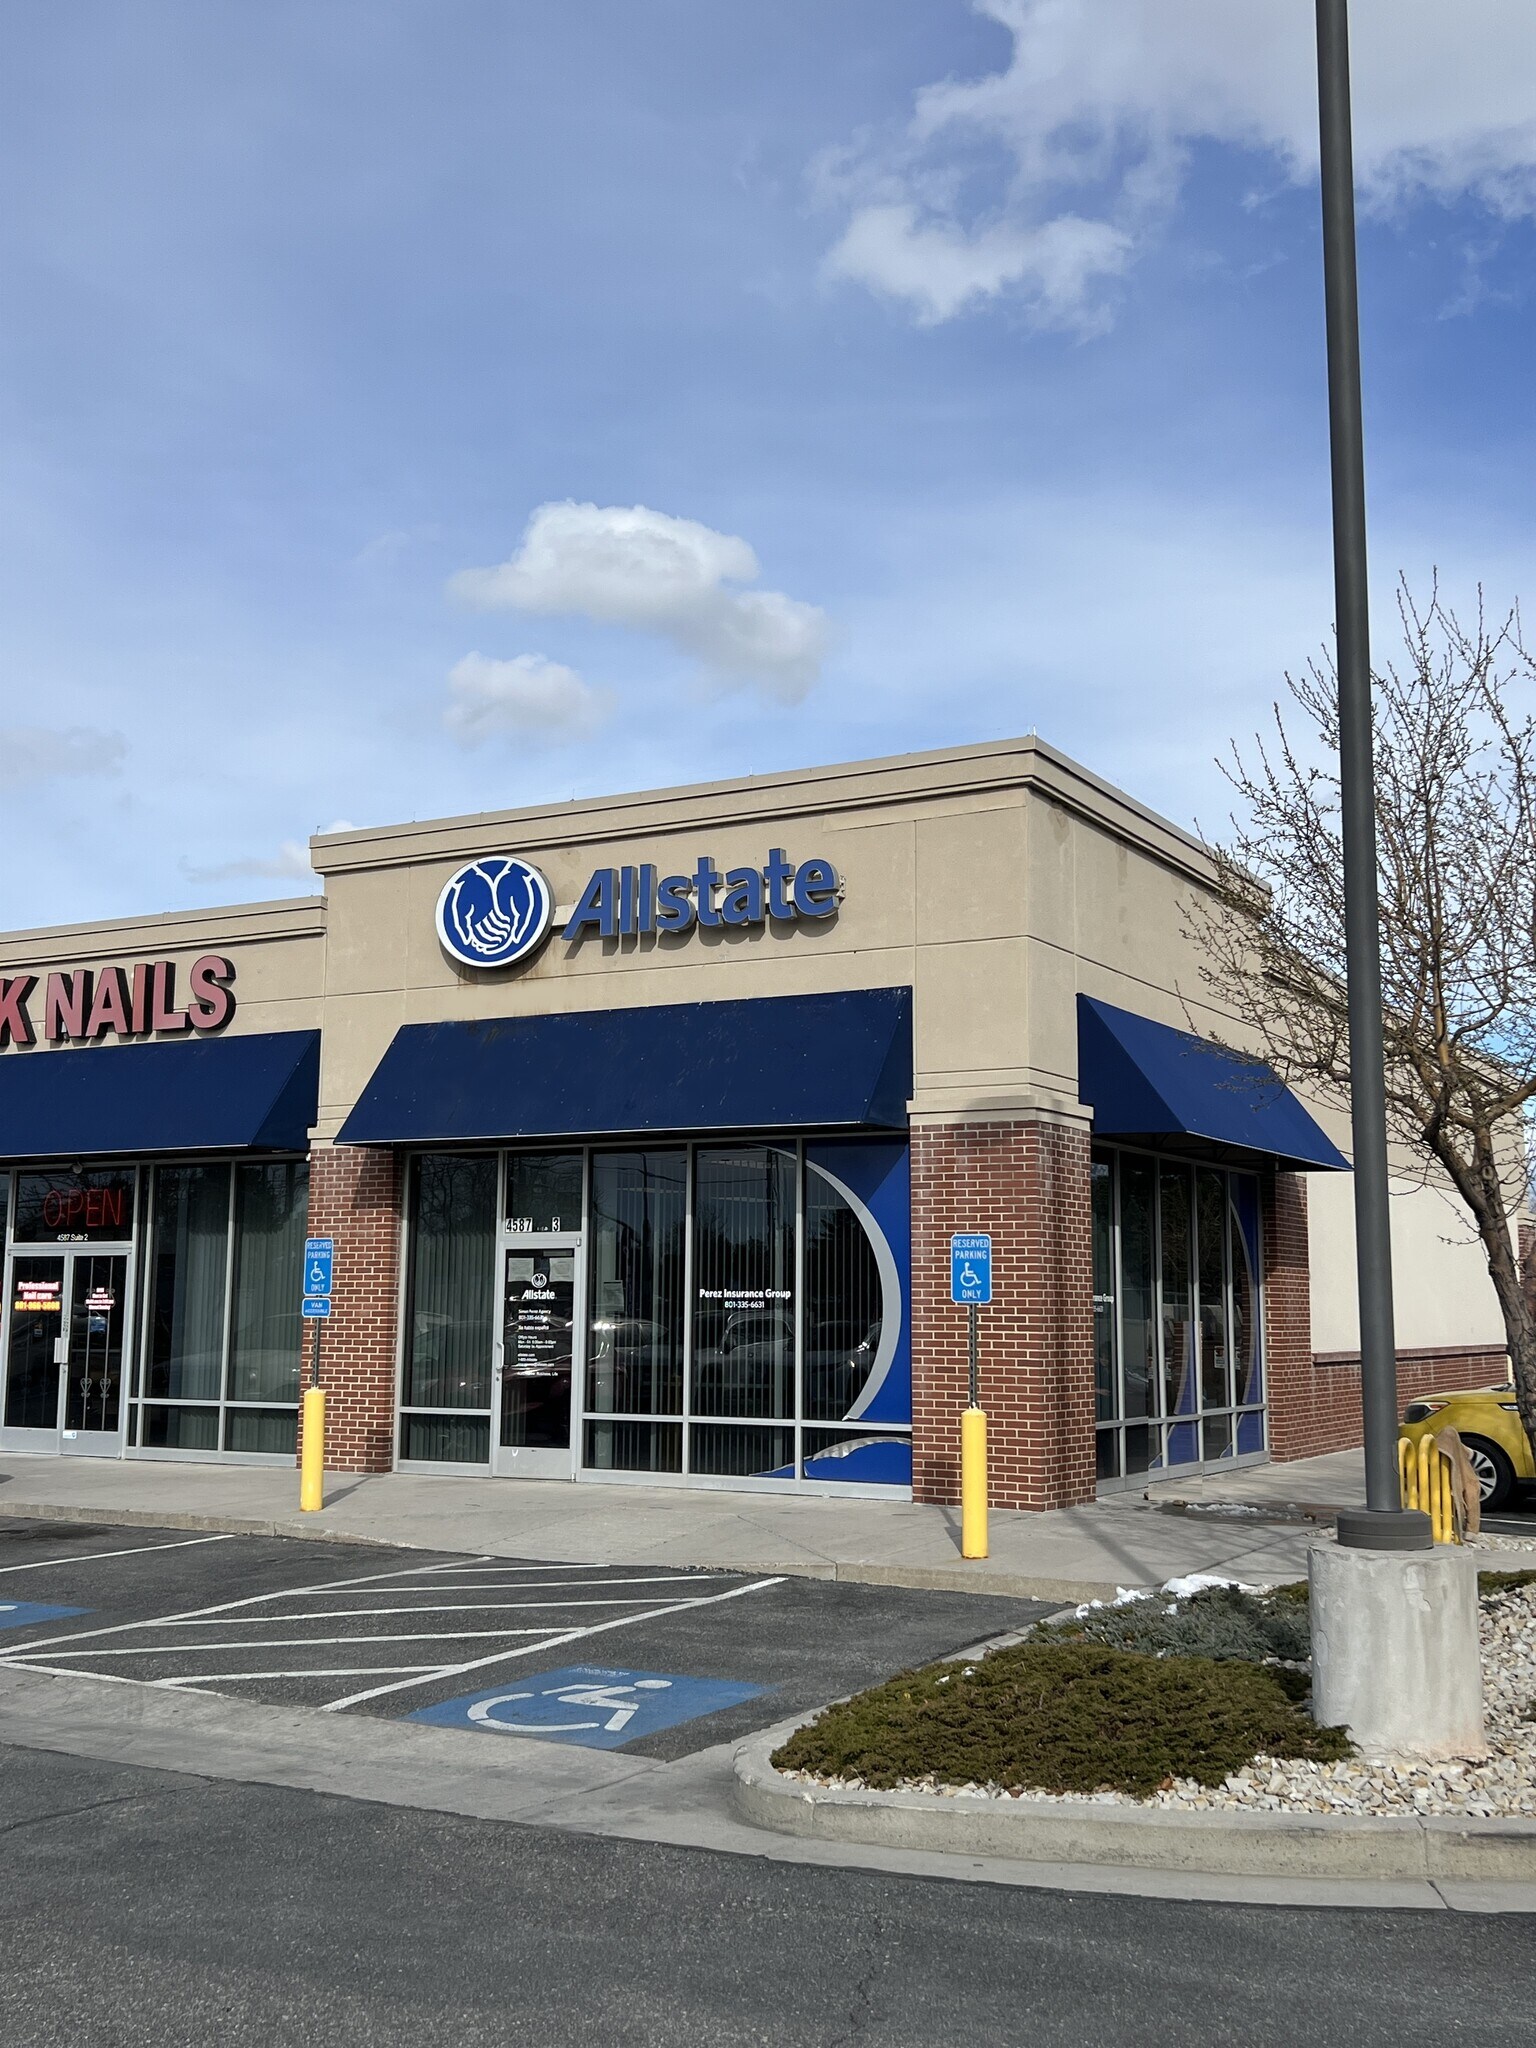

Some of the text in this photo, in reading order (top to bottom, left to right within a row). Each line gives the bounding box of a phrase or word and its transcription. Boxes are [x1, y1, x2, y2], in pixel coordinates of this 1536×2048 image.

[561, 848, 842, 940] Allstate
[45, 955, 236, 1040] NAILS
[43, 1187, 122, 1228] OPEN
[506, 1217, 560, 1232] 4587 3
[306, 1241, 332, 1250] RESERVED
[952, 1238, 989, 1248] RESERVED
[307, 1251, 331, 1259] PARKING
[955, 1250, 987, 1260] PARKING
[18, 1281, 59, 1291] Professional
[310, 1283, 325, 1292] ONLY
[521, 1289, 556, 1300] Allstate
[699, 1288, 791, 1300] Perez Insurance Group
[961, 1289, 982, 1299] ONLY
[311, 1301, 323, 1309] VAN
[724, 1300, 765, 1309] 801-335-6631
